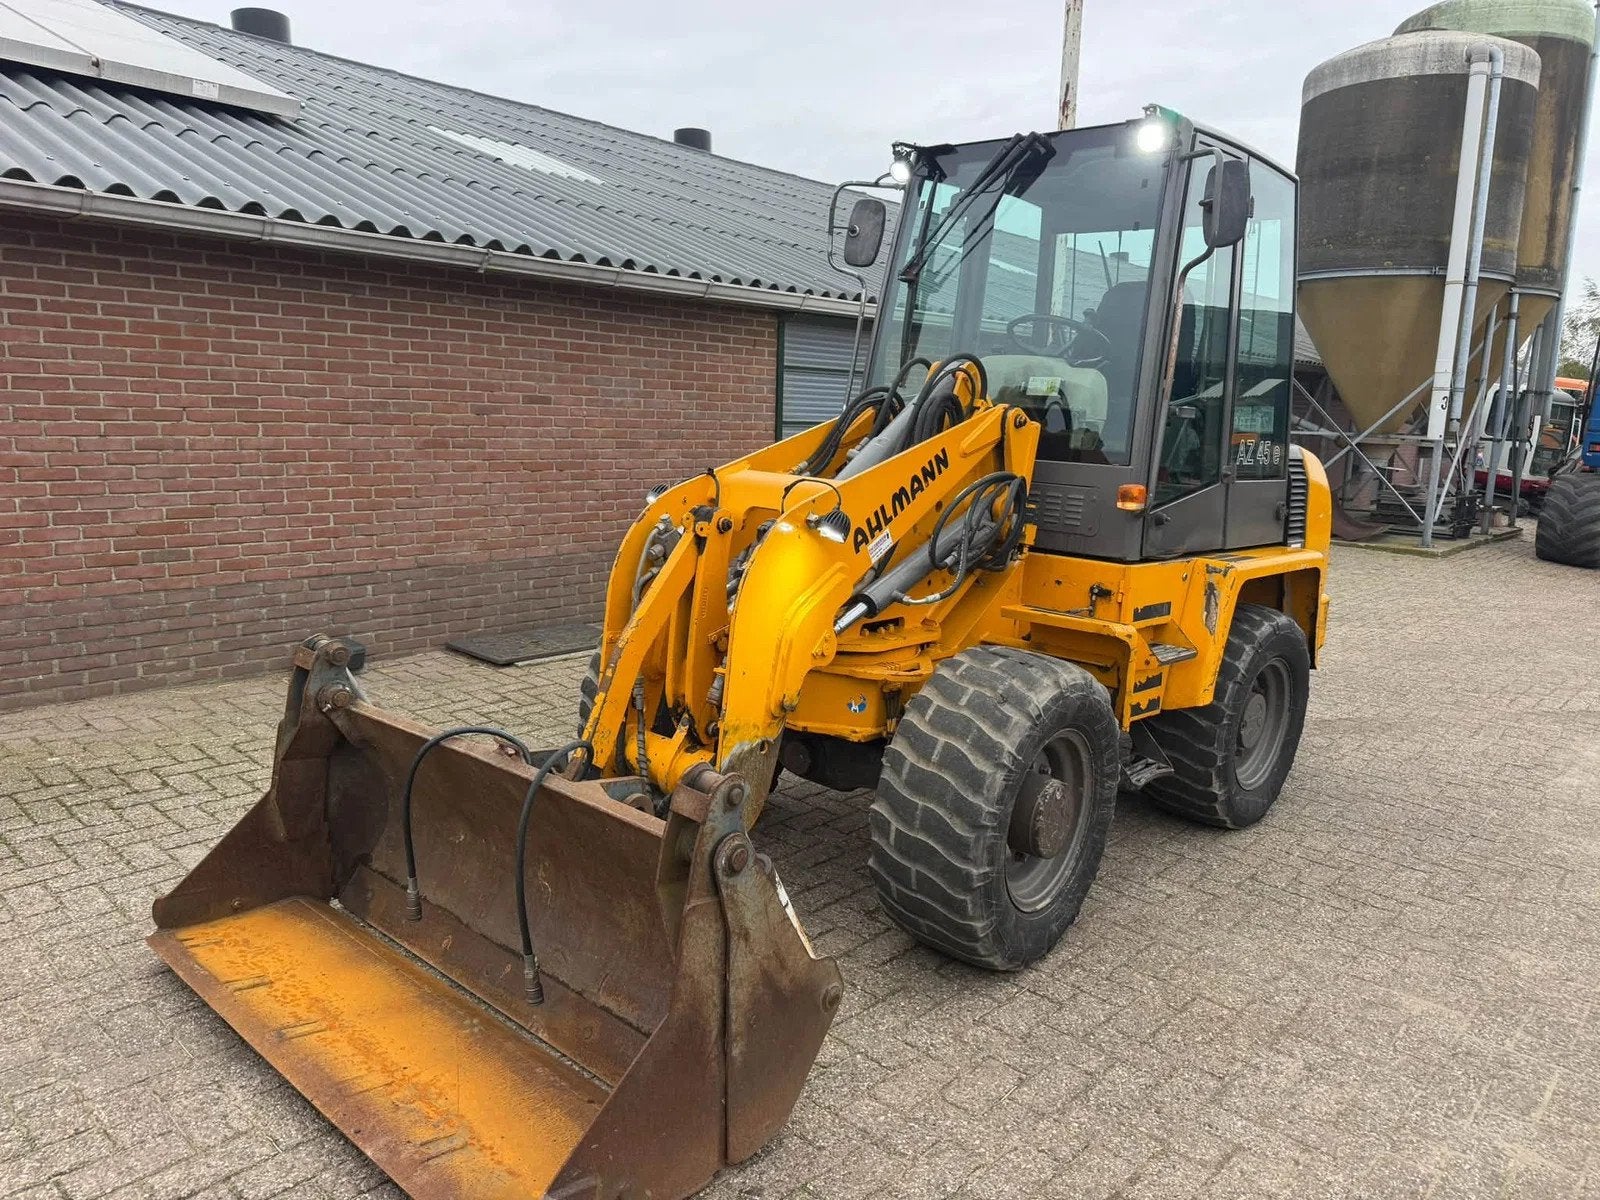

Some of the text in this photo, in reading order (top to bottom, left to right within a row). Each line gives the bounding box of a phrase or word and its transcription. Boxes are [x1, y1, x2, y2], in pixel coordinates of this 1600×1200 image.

[1440, 395, 1448, 410] 3
[1236, 439, 1255, 465] AZ
[1257, 440, 1271, 465] 45
[853, 447, 949, 555] AHLMANN
